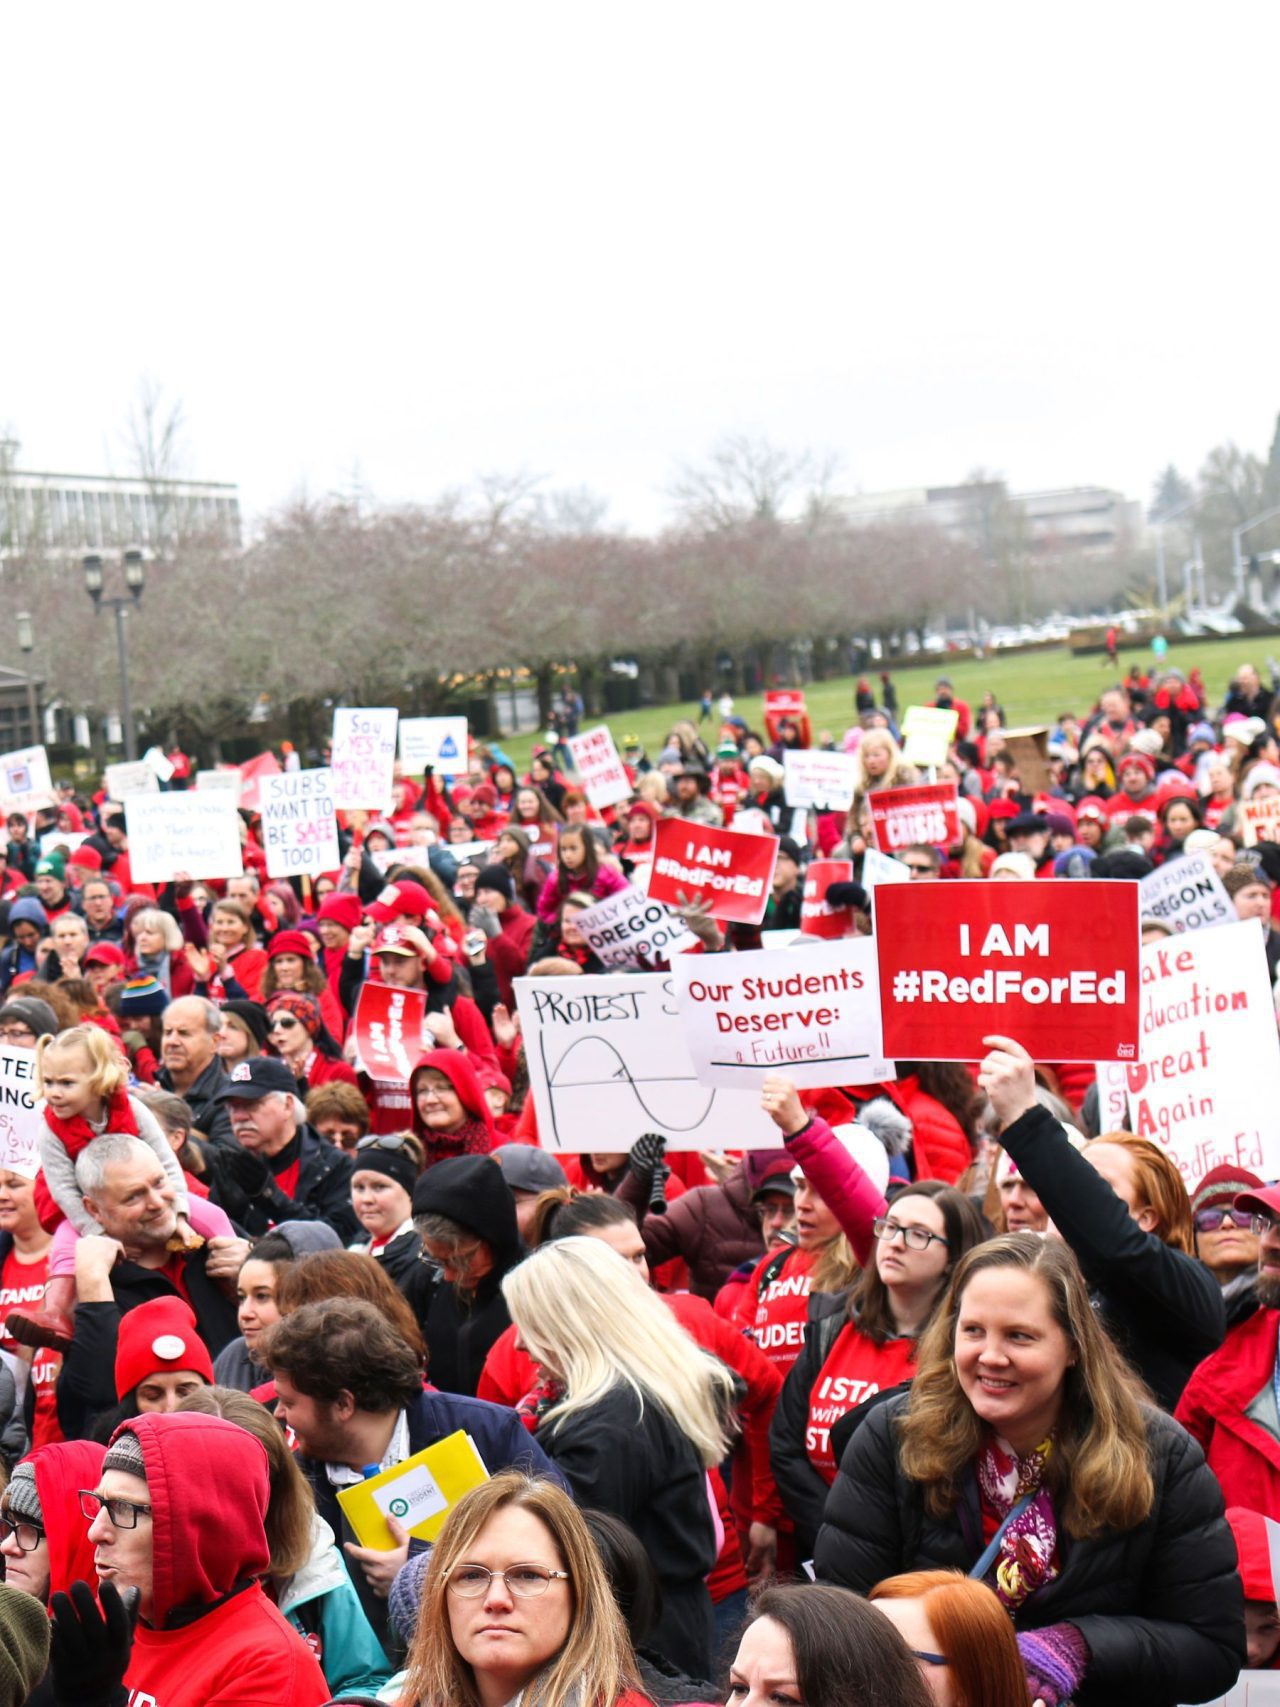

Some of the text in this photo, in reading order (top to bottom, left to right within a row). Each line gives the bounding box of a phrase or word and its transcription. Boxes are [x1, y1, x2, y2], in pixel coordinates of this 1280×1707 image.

[270, 773, 327, 798] SUBS
[265, 797, 333, 819] WANT TO
[269, 818, 334, 846] BE SAFE
[686, 842, 732, 868] I AM
[655, 856, 764, 897] #RedForEd
[576, 904, 620, 930] FULLY
[960, 924, 1049, 956] I AM
[1141, 947, 1195, 986] ake
[689, 980, 734, 1002] Our
[743, 968, 865, 1001] Students
[893, 970, 1126, 1004] #RedForEd
[532, 990, 647, 1025] PROTEST
[716, 1005, 840, 1033] Deserve:
[1144, 983, 1248, 1034] ducation
[736, 1050, 744, 1063] a
[1137, 1094, 1214, 1145] Again
[819, 1377, 880, 1404] I STA
